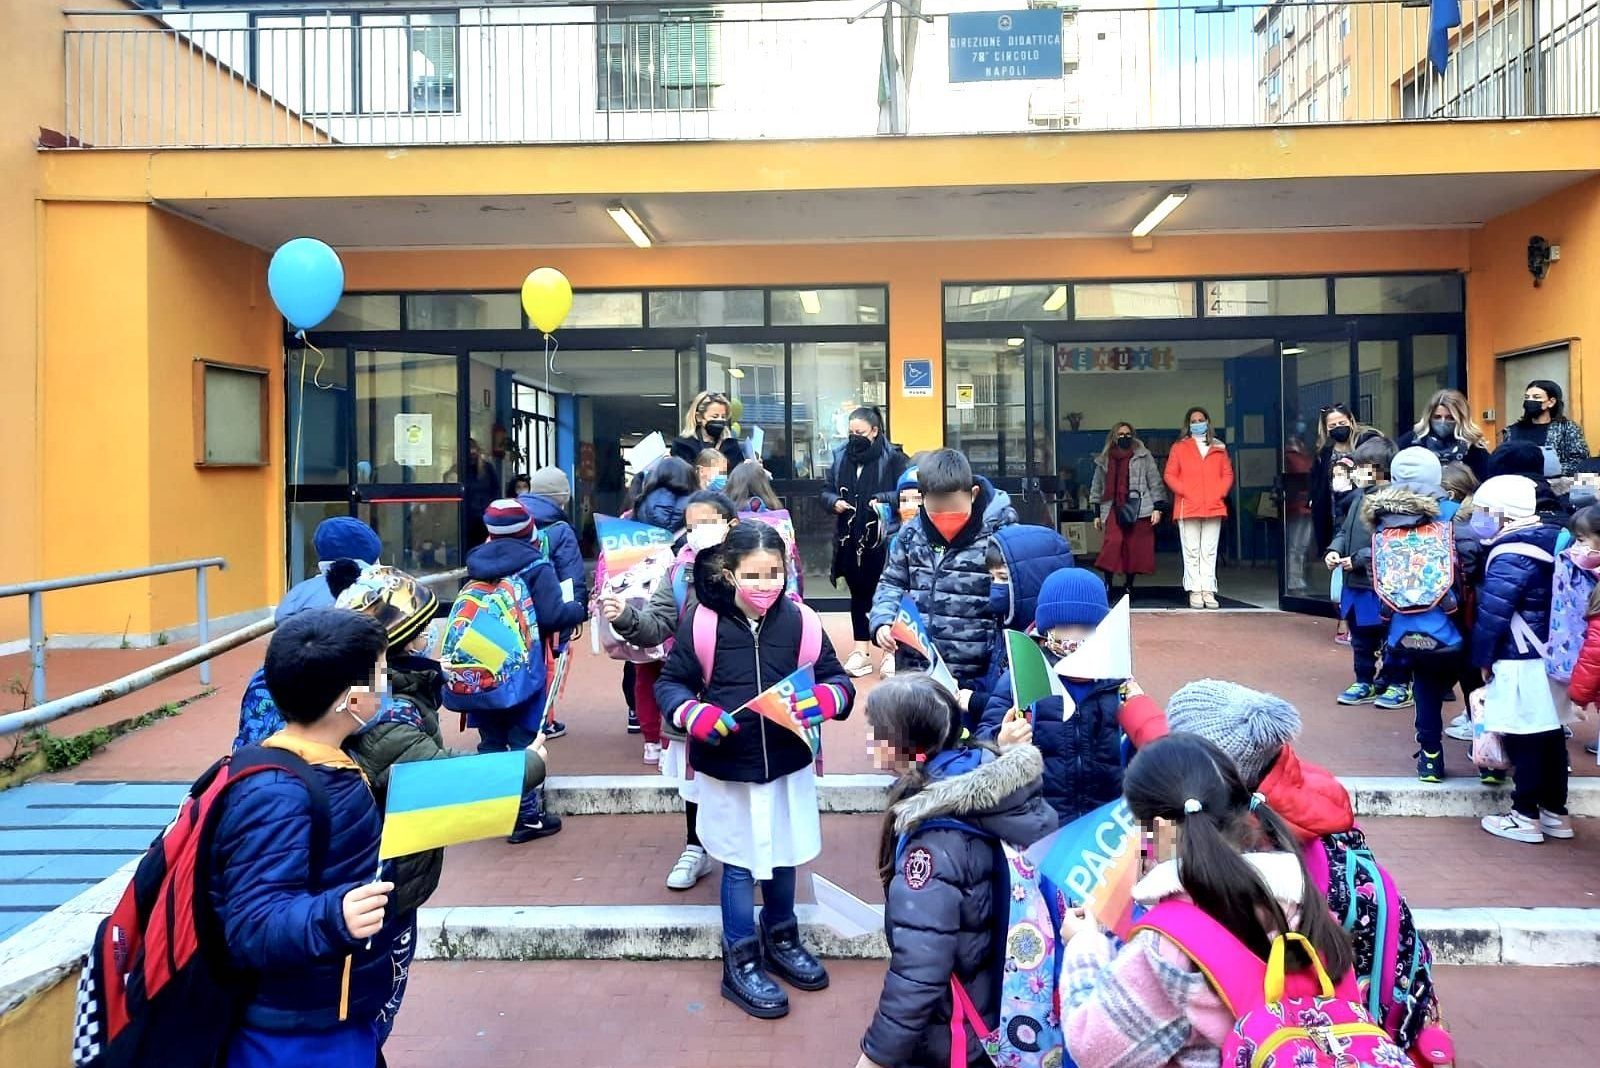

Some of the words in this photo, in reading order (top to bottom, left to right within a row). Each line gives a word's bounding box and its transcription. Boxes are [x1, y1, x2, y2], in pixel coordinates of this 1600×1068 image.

[950, 37, 1001, 49] DIREZIONE
[1008, 34, 1061, 46] DIDATTICA
[994, 49, 1040, 62] CIRCOLO
[985, 65, 1027, 77] NAPOLI
[602, 528, 667, 551] PACE
[897, 609, 929, 651] PAC
[1064, 800, 1137, 905] PACE
